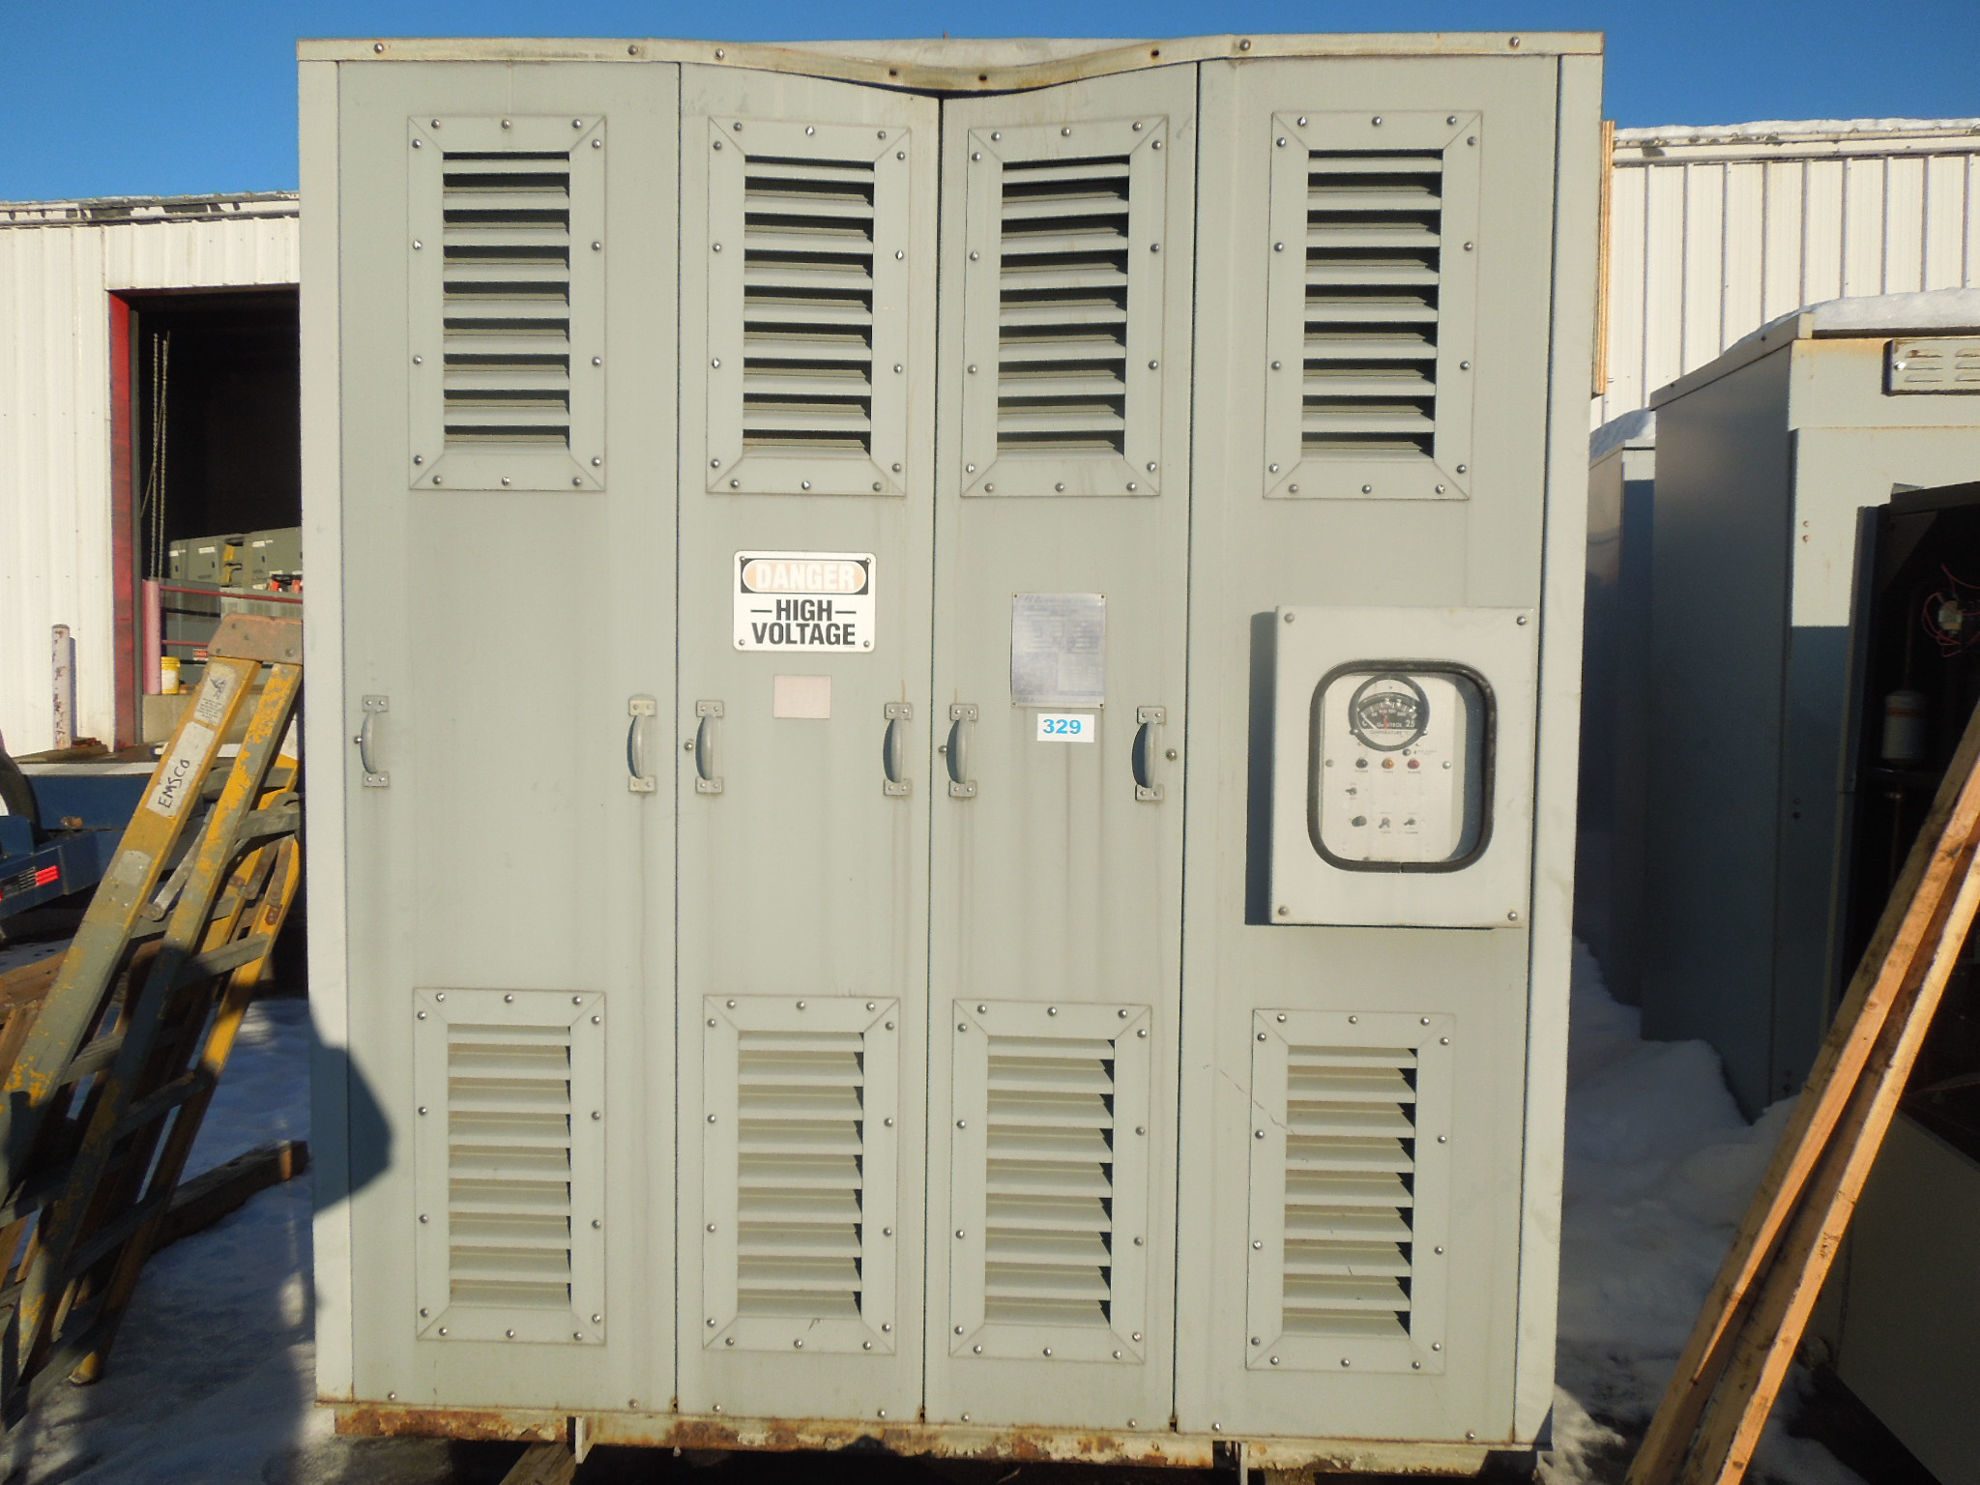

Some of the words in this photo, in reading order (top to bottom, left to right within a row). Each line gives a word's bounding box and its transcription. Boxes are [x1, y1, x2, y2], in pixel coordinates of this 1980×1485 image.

[756, 564, 856, 590] DANGER
[776, 599, 833, 621] HIGH
[751, 622, 856, 645] VOLTAGE
[1043, 718, 1082, 735] 329
